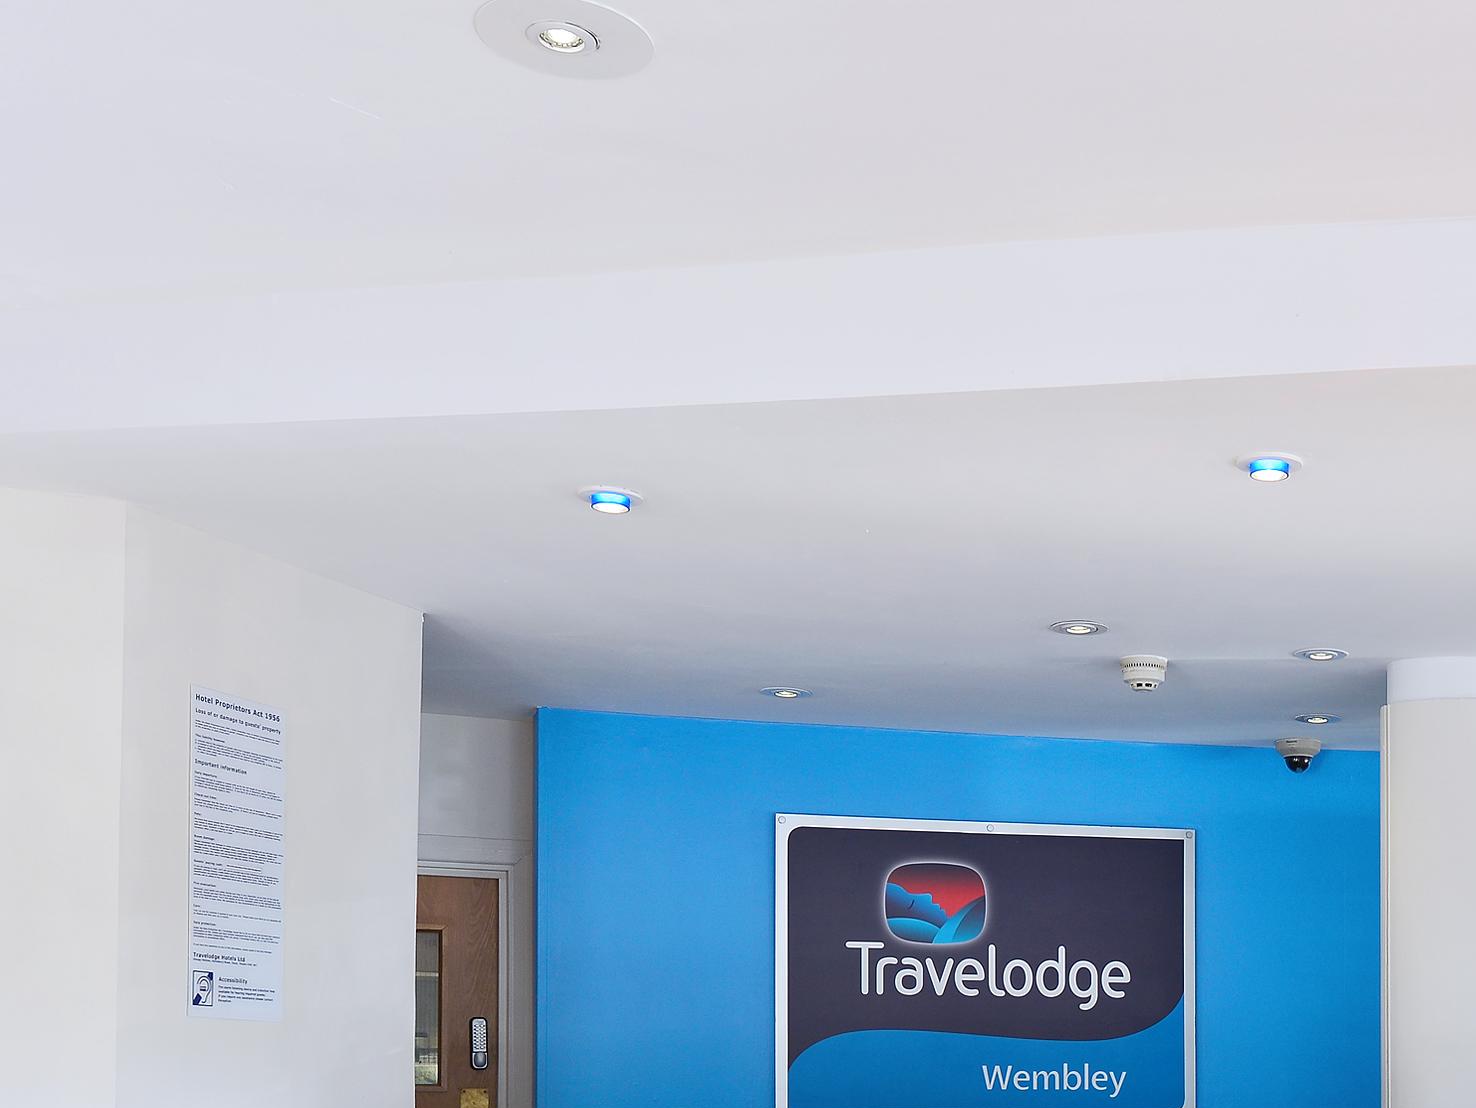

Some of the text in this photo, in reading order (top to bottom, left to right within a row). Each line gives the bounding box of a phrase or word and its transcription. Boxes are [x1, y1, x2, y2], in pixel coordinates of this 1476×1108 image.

[195, 693, 280, 722] Hotel Proprietors Act 1956
[219, 714, 238, 723] damage
[262, 726, 281, 735] property
[194, 758, 219, 769] Important
[220, 764, 247, 775] information
[192, 952, 220, 960] Travelodge
[845, 941, 1131, 1010] Travelodge
[982, 1063, 1127, 1098] Wembley
